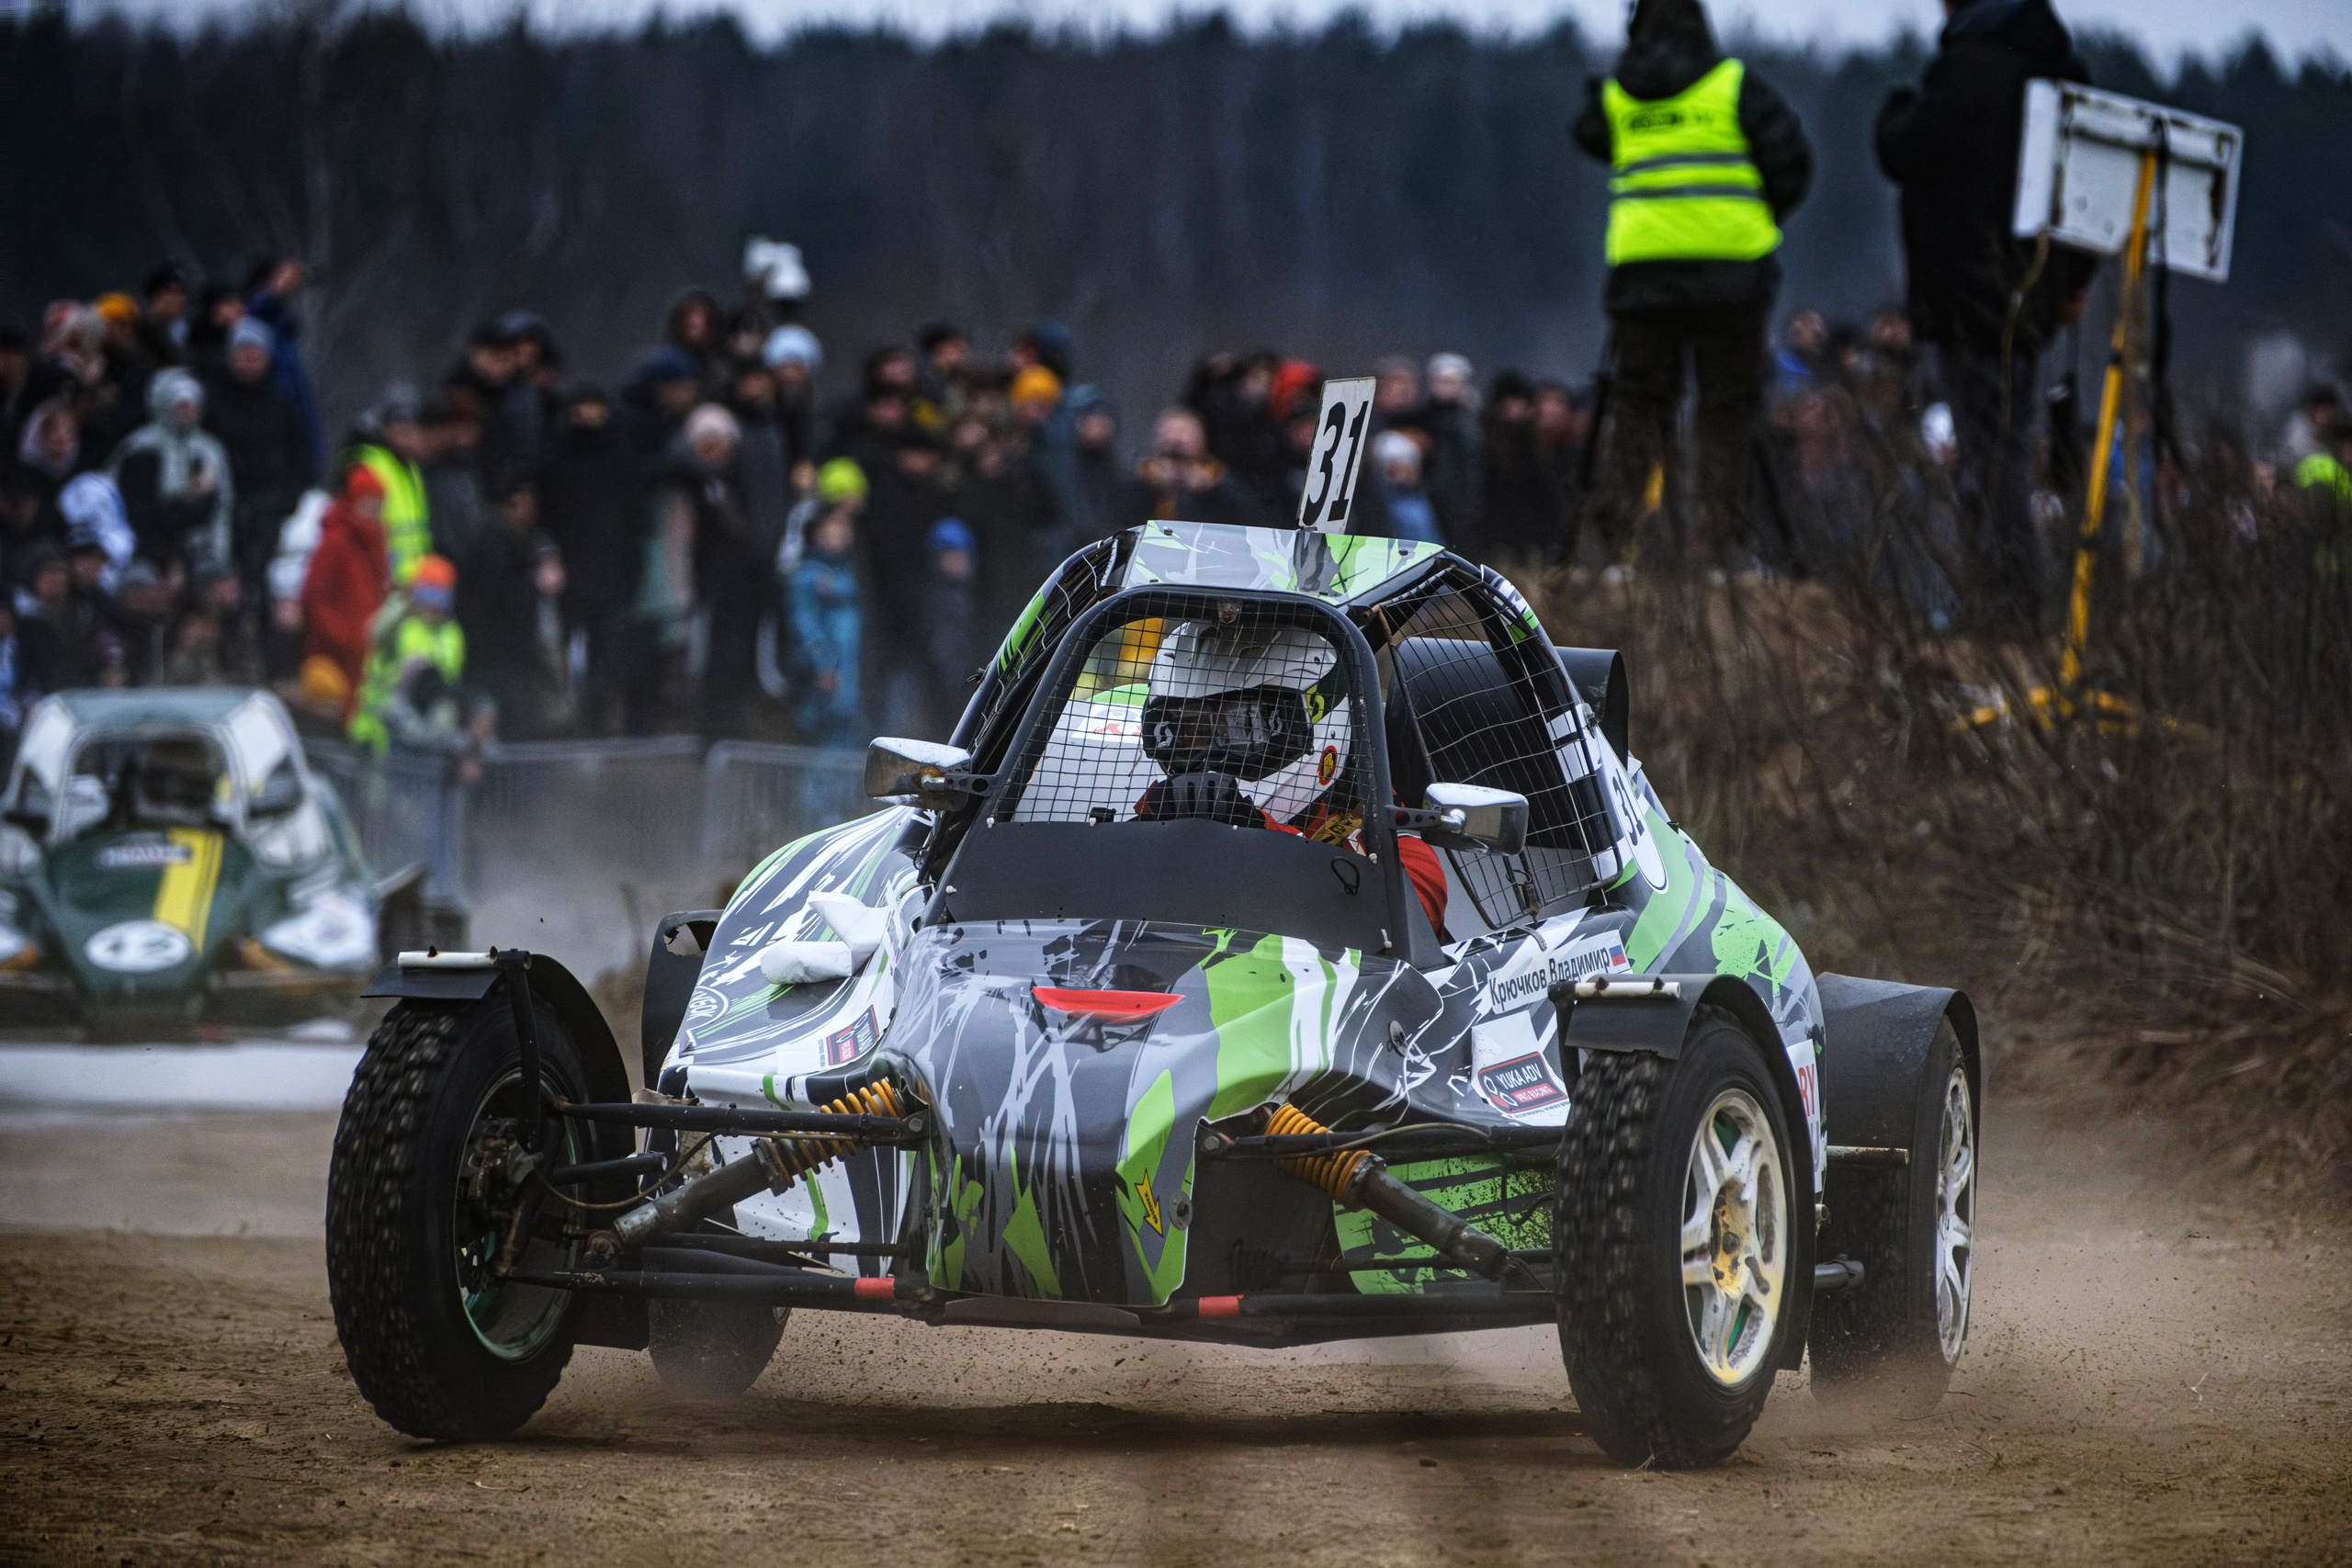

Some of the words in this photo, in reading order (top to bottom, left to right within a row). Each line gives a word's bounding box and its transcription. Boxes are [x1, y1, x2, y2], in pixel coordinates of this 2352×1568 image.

[1302, 400, 1369, 526] 31
[1612, 768, 1645, 846] 31
[1489, 968, 1547, 1011] Крючков
[1548, 947, 1611, 983] Владимир
[1496, 1069, 1527, 1089] YUKA
[1522, 1063, 1543, 1083] ADV
[1515, 1092, 1532, 1101] PRO
[1529, 1085, 1554, 1099] RACING
